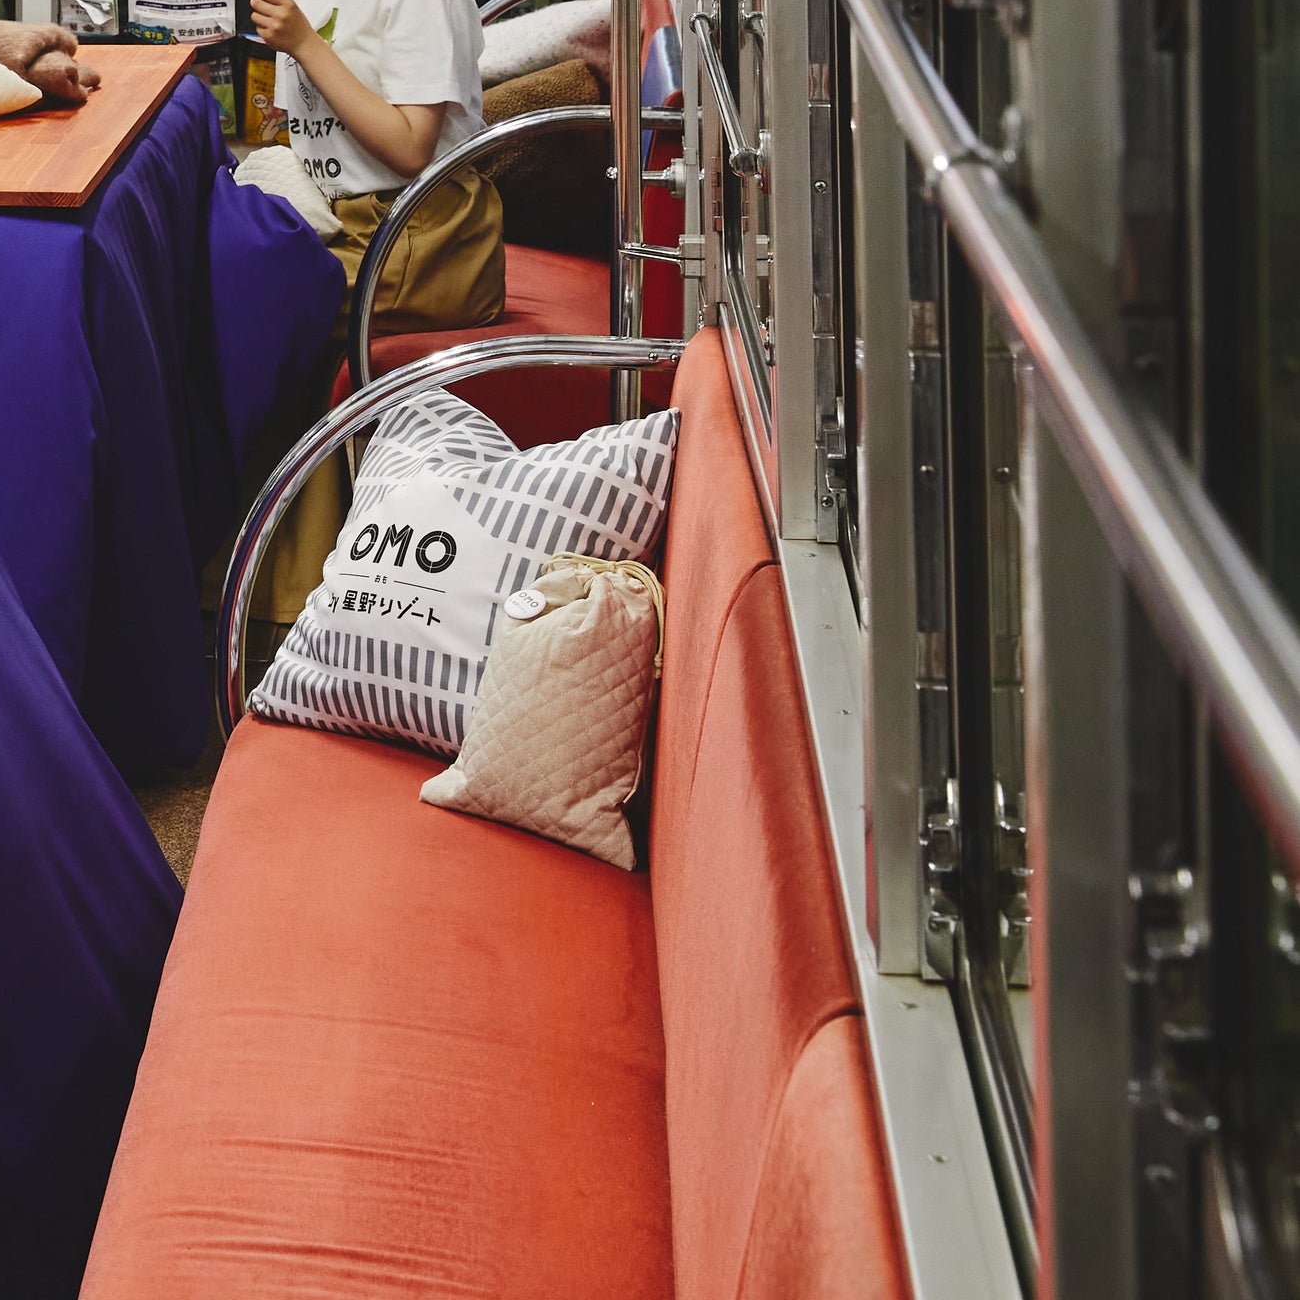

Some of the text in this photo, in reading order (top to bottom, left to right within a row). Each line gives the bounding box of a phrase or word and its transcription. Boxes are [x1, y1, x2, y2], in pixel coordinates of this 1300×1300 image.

[350, 523, 458, 574] OMO
[342, 589, 441, 627] 星野リゾート
[518, 591, 539, 608] OMO
